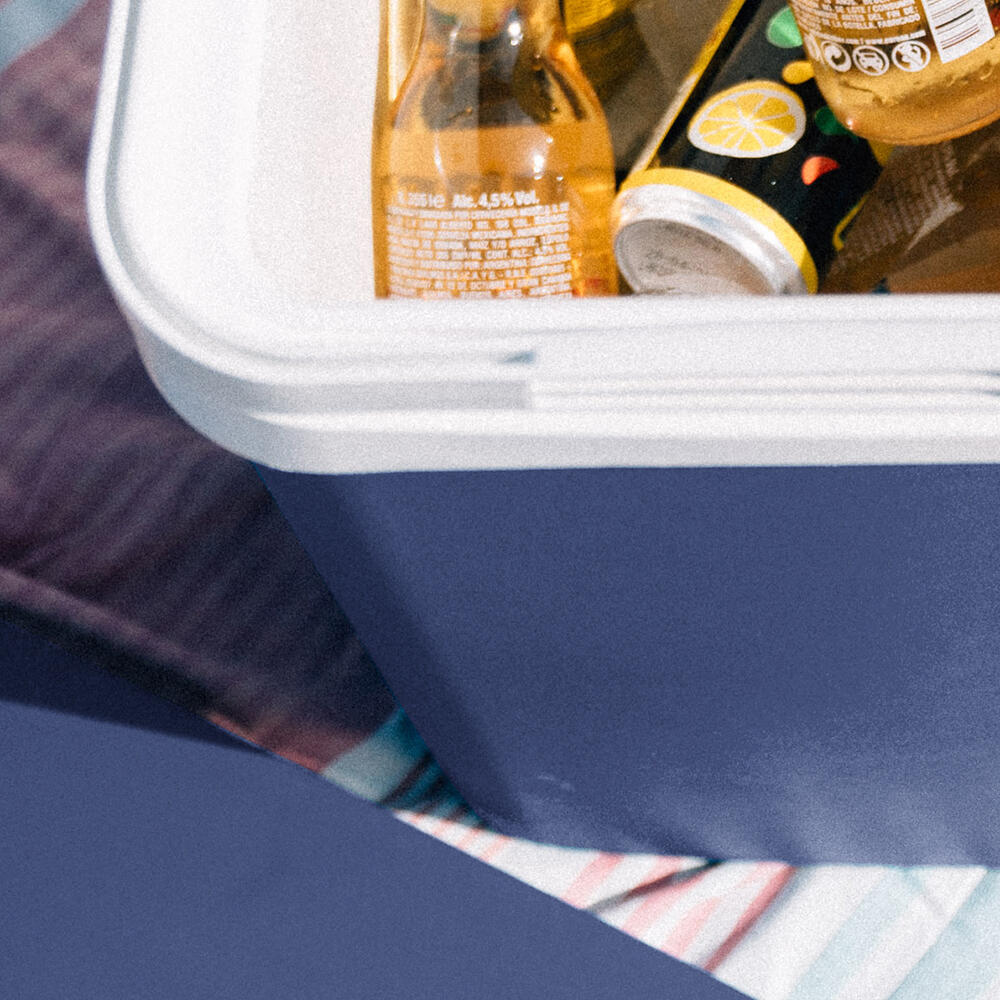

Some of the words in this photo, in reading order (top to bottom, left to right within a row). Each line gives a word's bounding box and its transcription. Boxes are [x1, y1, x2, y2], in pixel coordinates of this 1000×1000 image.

[453, 194, 478, 208] Alc.
[479, 190, 514, 208] 4,5%
[514, 188, 540, 206] Vol.
